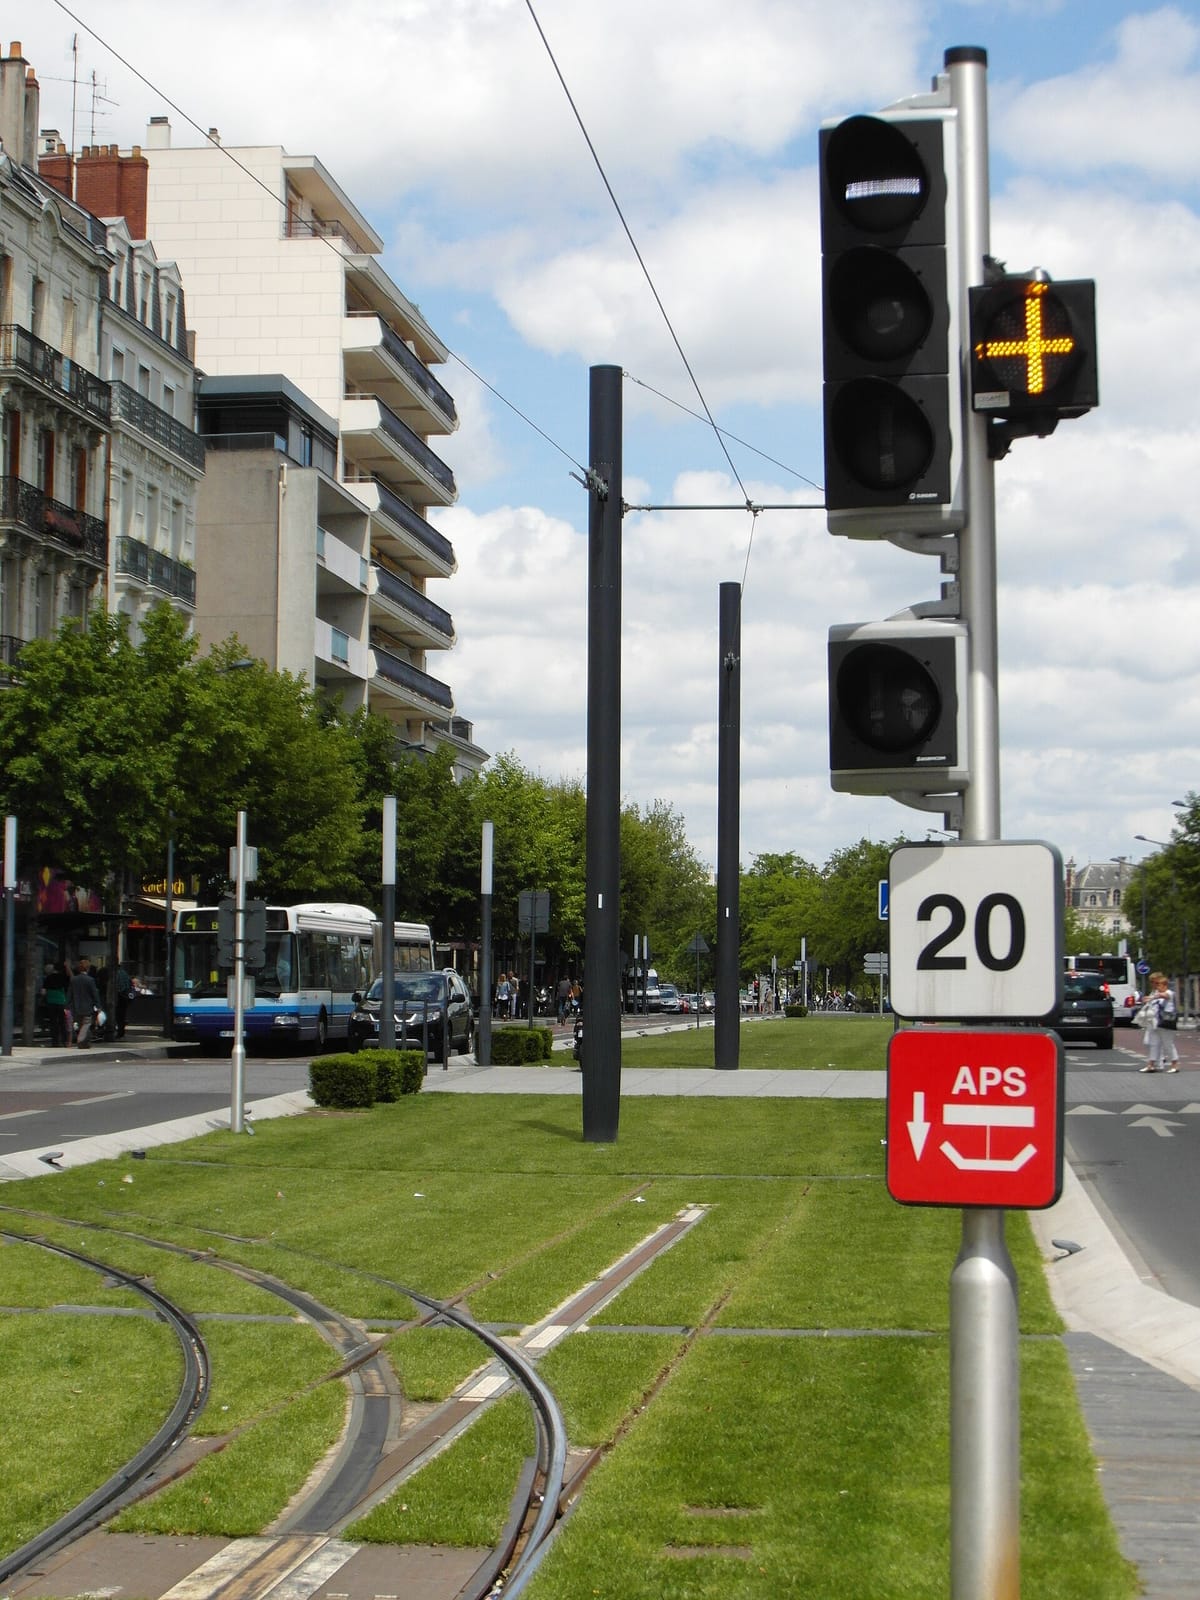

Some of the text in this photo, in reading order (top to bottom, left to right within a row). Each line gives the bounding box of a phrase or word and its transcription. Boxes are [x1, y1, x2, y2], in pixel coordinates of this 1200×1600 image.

[185, 914, 197, 931] 4
[916, 892, 1026, 972] 20
[951, 1065, 1027, 1098] APS
